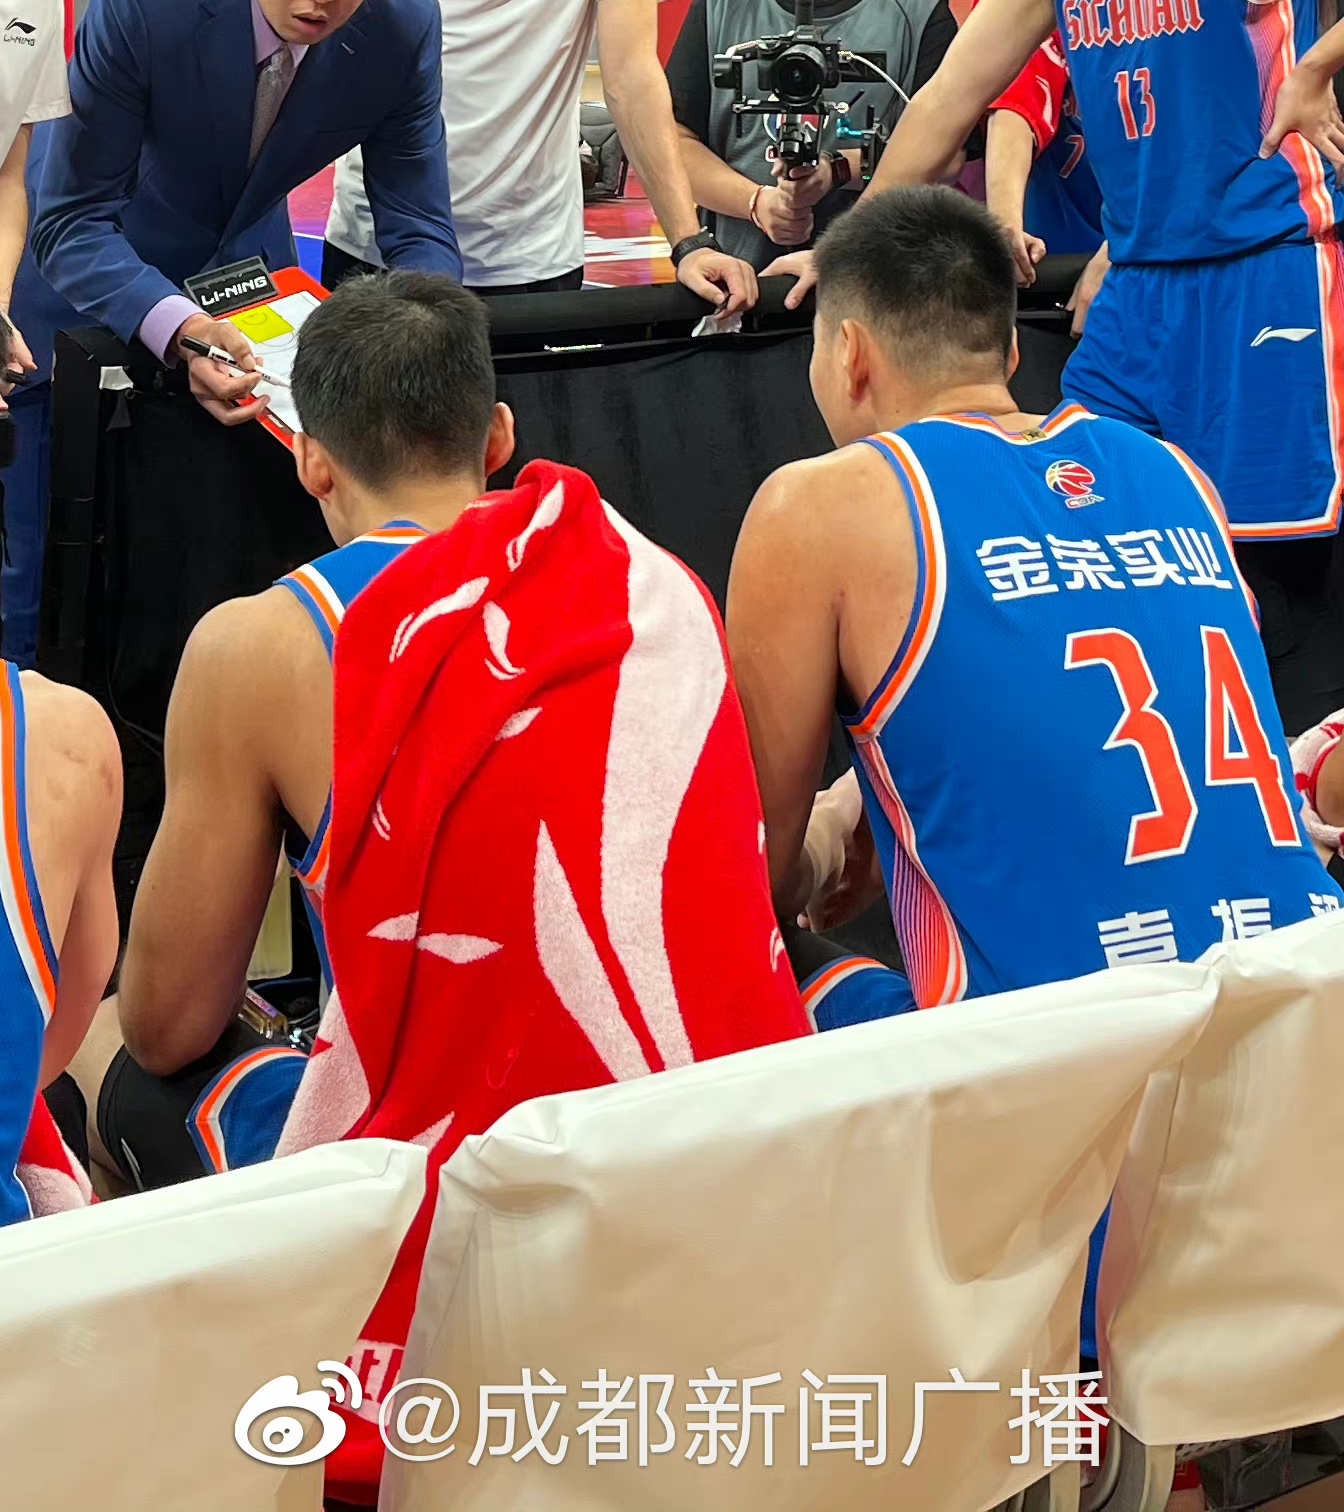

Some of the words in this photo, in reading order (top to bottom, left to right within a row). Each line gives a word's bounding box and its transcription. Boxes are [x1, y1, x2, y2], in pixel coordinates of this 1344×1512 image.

[1113, 66, 1156, 141] 13
[200, 275, 269, 307] LI-NING
[975, 525, 1234, 603] 金荣实业
[1063, 623, 1303, 866] 34
